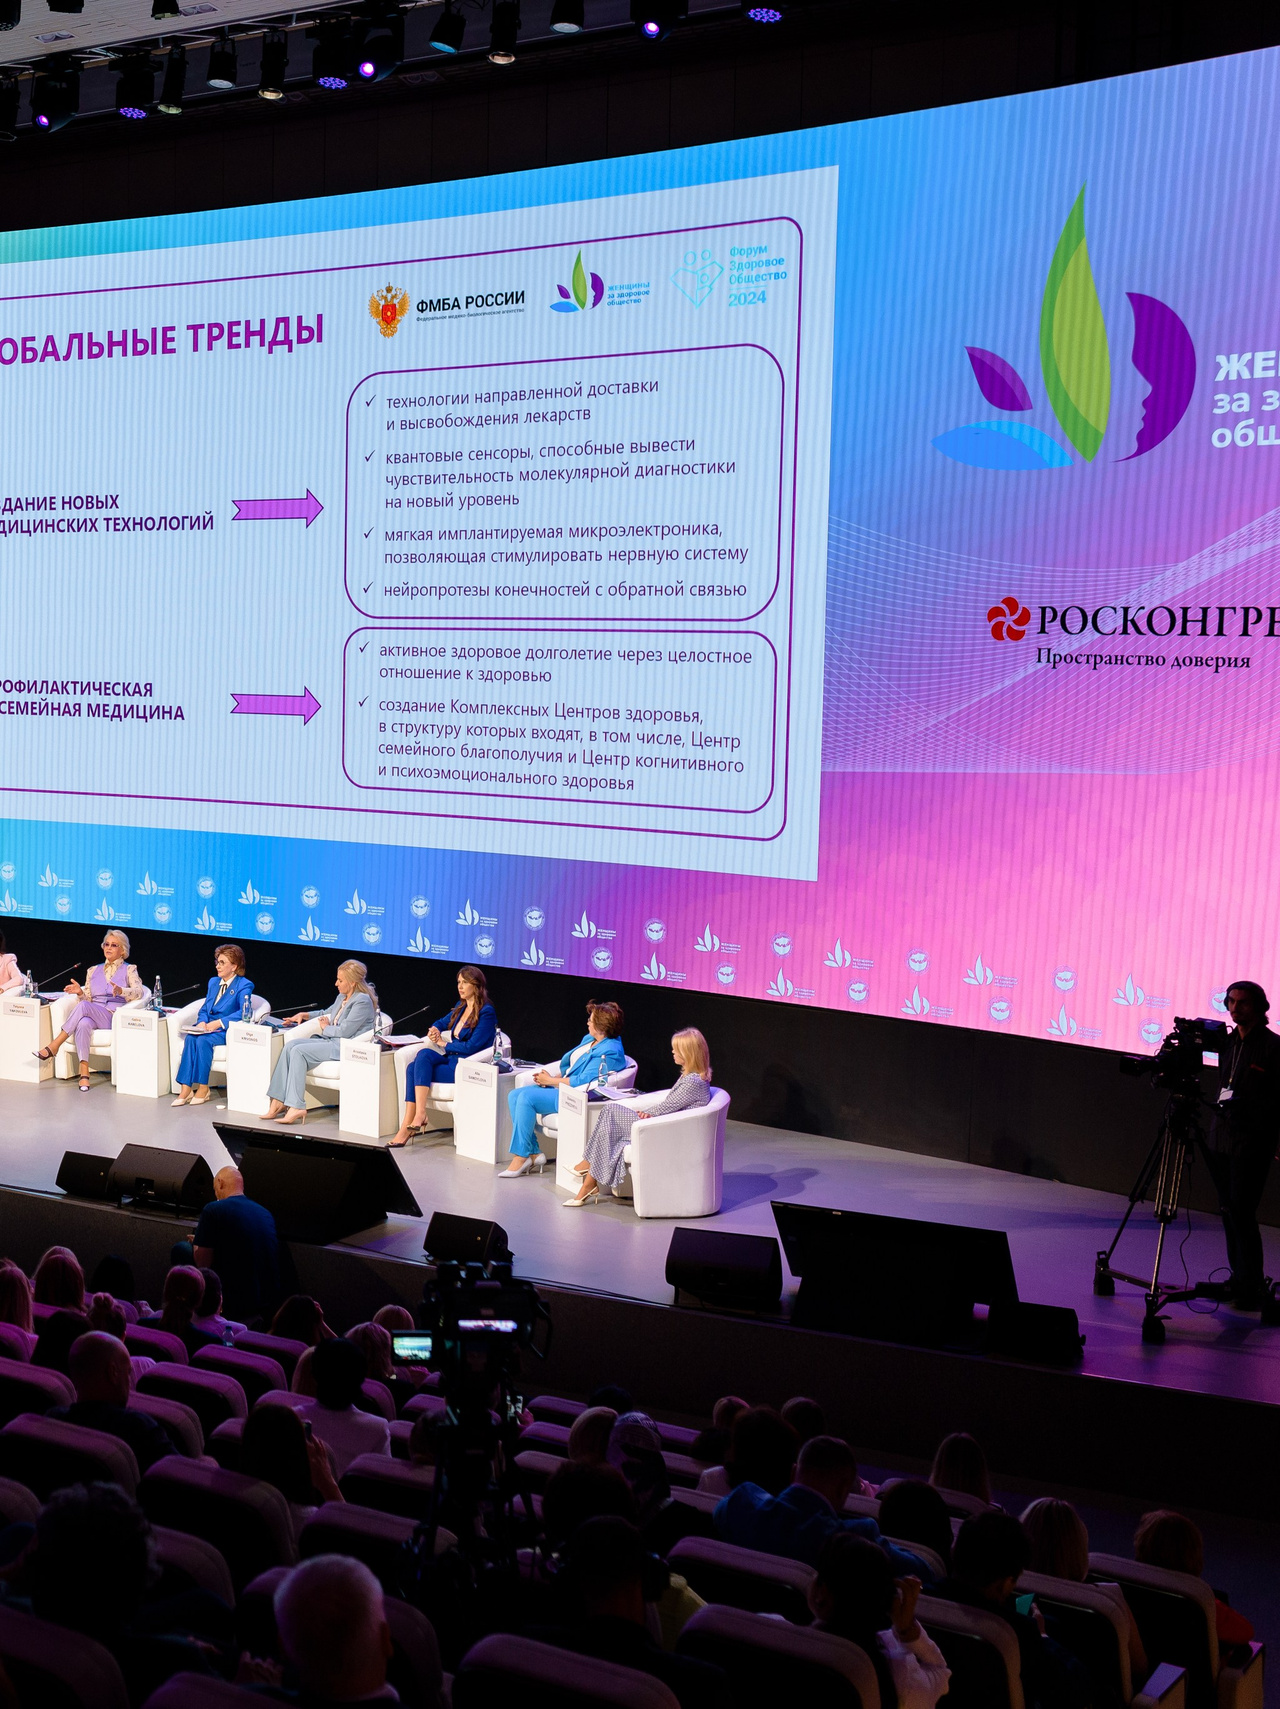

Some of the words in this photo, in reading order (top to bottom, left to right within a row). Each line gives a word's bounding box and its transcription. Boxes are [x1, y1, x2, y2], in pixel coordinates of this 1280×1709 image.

[730, 245, 768, 258] Форум
[729, 257, 785, 272] Здоровое
[607, 282, 650, 291] ЖЕНЩИНЫ
[729, 271, 787, 285] Общество
[416, 296, 461, 314] ФМБА
[465, 290, 525, 309] РОССИИ
[606, 298, 642, 306] общество
[616, 289, 650, 299] здоровое
[728, 290, 767, 307] 2024
[187, 314, 323, 354] ТРЕНДЫ
[1214, 350, 1280, 382] ЖЕ
[387, 394, 469, 408] технологии
[475, 381, 582, 406] направленной
[587, 381, 658, 398] доставки
[1212, 392, 1250, 415] за
[387, 421, 394, 430] и
[401, 413, 518, 430] высвобождения
[524, 409, 590, 425] лекарств
[387, 451, 463, 464] квантовые
[469, 448, 533, 463] сенсоры,
[540, 440, 624, 457] способные
[631, 440, 694, 453] вывести
[386, 472, 513, 490] чувствительность
[520, 462, 629, 484] молекулярной
[635, 462, 735, 479] диагностики
[62, 495, 119, 510] НОВЫХ
[386, 498, 401, 508] на
[407, 492, 453, 507] новый
[459, 495, 519, 510] уровень
[103, 511, 213, 532] ТЕХНОЛОГИЙ
[385, 531, 432, 541] мягкая
[439, 528, 562, 543] имплантируемая
[569, 524, 722, 541] микроэлектроника,
[385, 552, 485, 565] позволяющая
[491, 551, 602, 566] стимулировать
[609, 550, 679, 565] нервную
[685, 549, 748, 564] систему
[385, 582, 489, 600] нейропротезы
[495, 581, 589, 596] конечностей
[596, 586, 602, 596] с
[608, 580, 683, 600] обратной
[690, 585, 746, 596] связью
[380, 646, 446, 657] активное
[451, 647, 521, 661] здоровое
[525, 649, 612, 661] долголетие
[618, 650, 662, 665] через
[669, 651, 752, 664] целостное
[1036, 647, 1166, 670] Пространство
[1171, 655, 1251, 674] доверия
[380, 668, 461, 679] отношение
[467, 670, 473, 680] к
[478, 670, 551, 685] здоровью
[88, 703, 185, 723] МЕДИЦИНА
[379, 701, 445, 714] создание
[451, 699, 549, 716] Комплексных
[555, 703, 620, 722] Центров
[626, 709, 702, 725] здоровья,
[380, 722, 386, 732] в
[392, 723, 461, 739] структуру
[467, 726, 526, 741] которых
[532, 729, 583, 743] входят,
[590, 731, 597, 741] в
[603, 732, 630, 743] том
[637, 733, 684, 748] числе,
[692, 731, 740, 752] Центр
[379, 741, 455, 757] семейного
[461, 743, 562, 765] благополучия
[569, 753, 576, 763] и
[583, 750, 630, 770] Центр
[636, 756, 744, 772] когнитивного
[379, 766, 386, 775] и
[392, 767, 557, 785] психоэмоционального
[563, 776, 633, 792] здоровья
